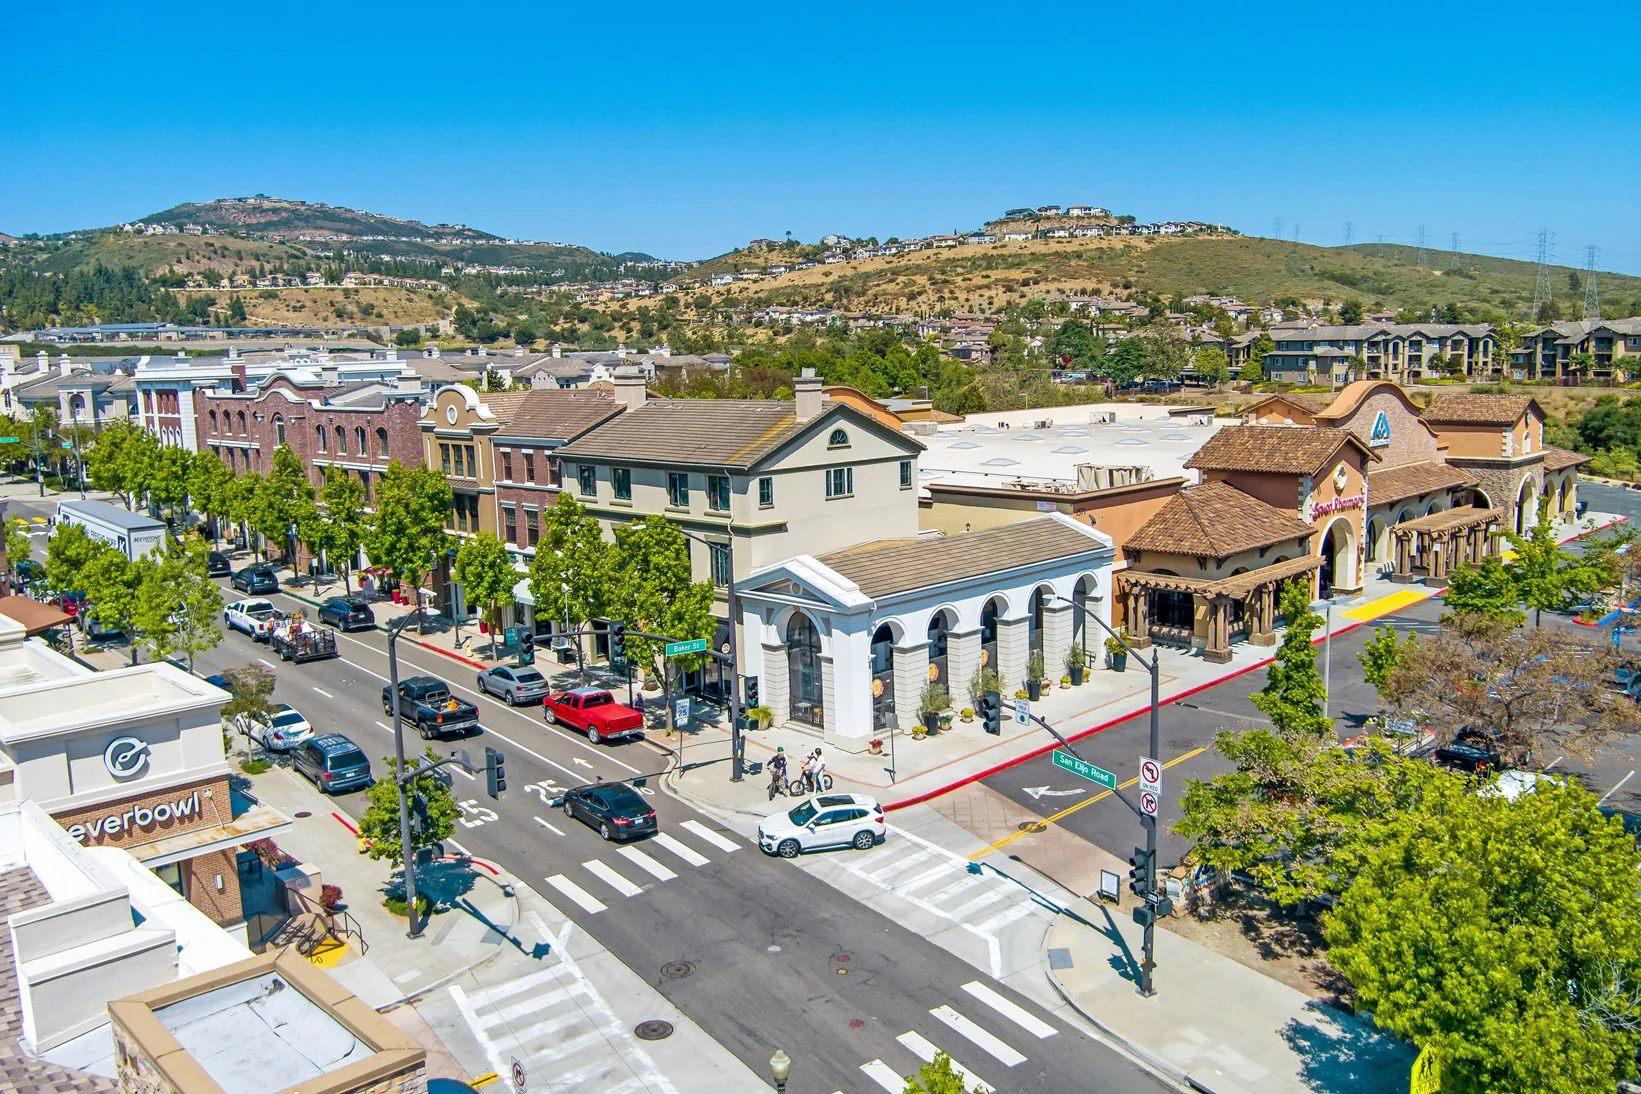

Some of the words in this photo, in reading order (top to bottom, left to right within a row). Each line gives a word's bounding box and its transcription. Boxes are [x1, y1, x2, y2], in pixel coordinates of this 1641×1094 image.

[1332, 495, 1365, 511] Pharmacy
[673, 644, 691, 653] Baker
[692, 642, 700, 650] St
[678, 709, 687, 717] 25
[1059, 755, 1073, 768] San
[1074, 761, 1089, 775] Elijo
[1091, 769, 1109, 782] Road
[68, 791, 199, 842] everbowl
